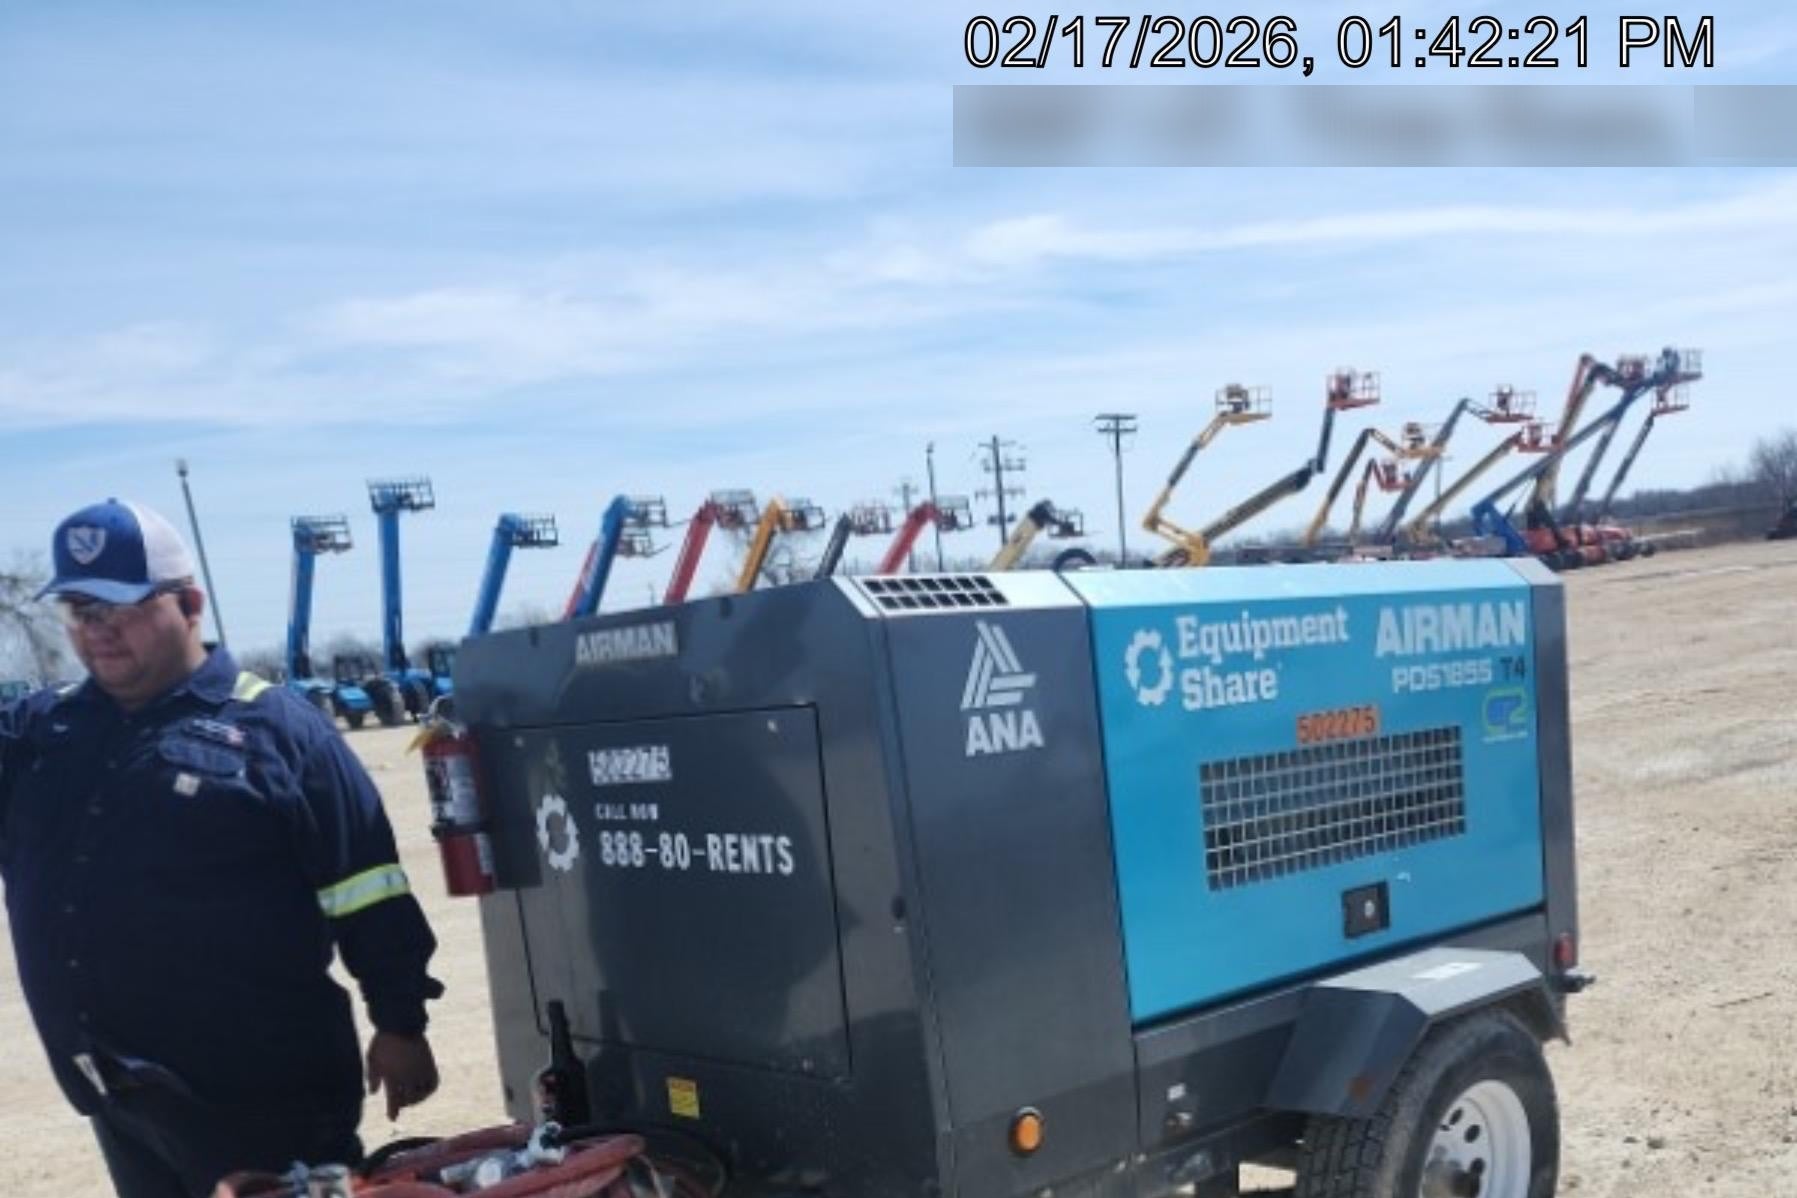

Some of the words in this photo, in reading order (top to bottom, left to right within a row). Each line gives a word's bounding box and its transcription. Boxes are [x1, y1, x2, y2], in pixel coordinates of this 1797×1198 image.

[575, 621, 677, 664] AIRMAN
[1176, 606, 1349, 664] Equipment
[1375, 600, 1526, 658] AIRMAN
[1180, 666, 1278, 711] Share
[966, 710, 1044, 757] ANA
[600, 830, 795, 876] 888-80-RENTS
